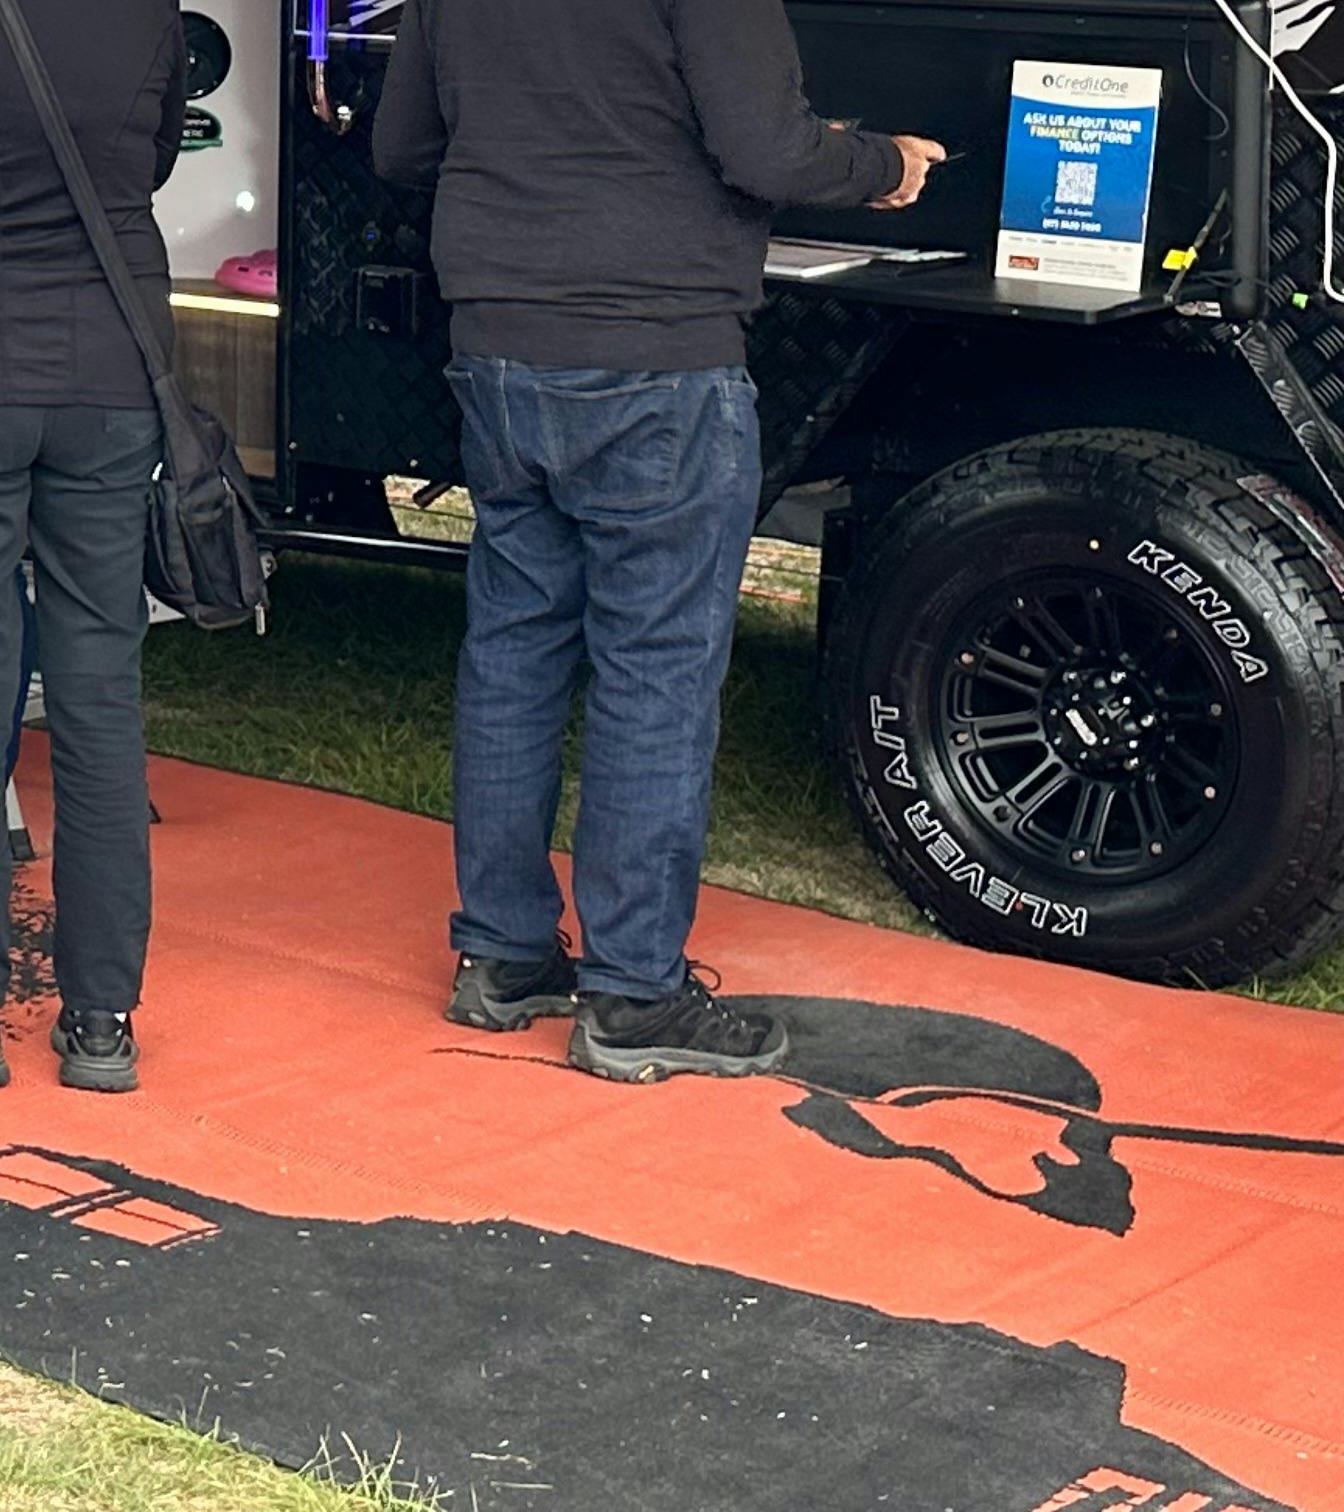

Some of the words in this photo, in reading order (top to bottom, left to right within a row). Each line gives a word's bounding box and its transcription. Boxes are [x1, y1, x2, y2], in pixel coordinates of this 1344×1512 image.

[1023, 112, 1047, 126] ASK
[1049, 114, 1065, 127] US
[1067, 115, 1107, 129] ABOUT
[1109, 118, 1142, 133] YOUR
[1081, 130, 1132, 145] OPTIONS
[1127, 539, 1269, 683] KENDA
[904, 800, 1088, 937] KLEVER
